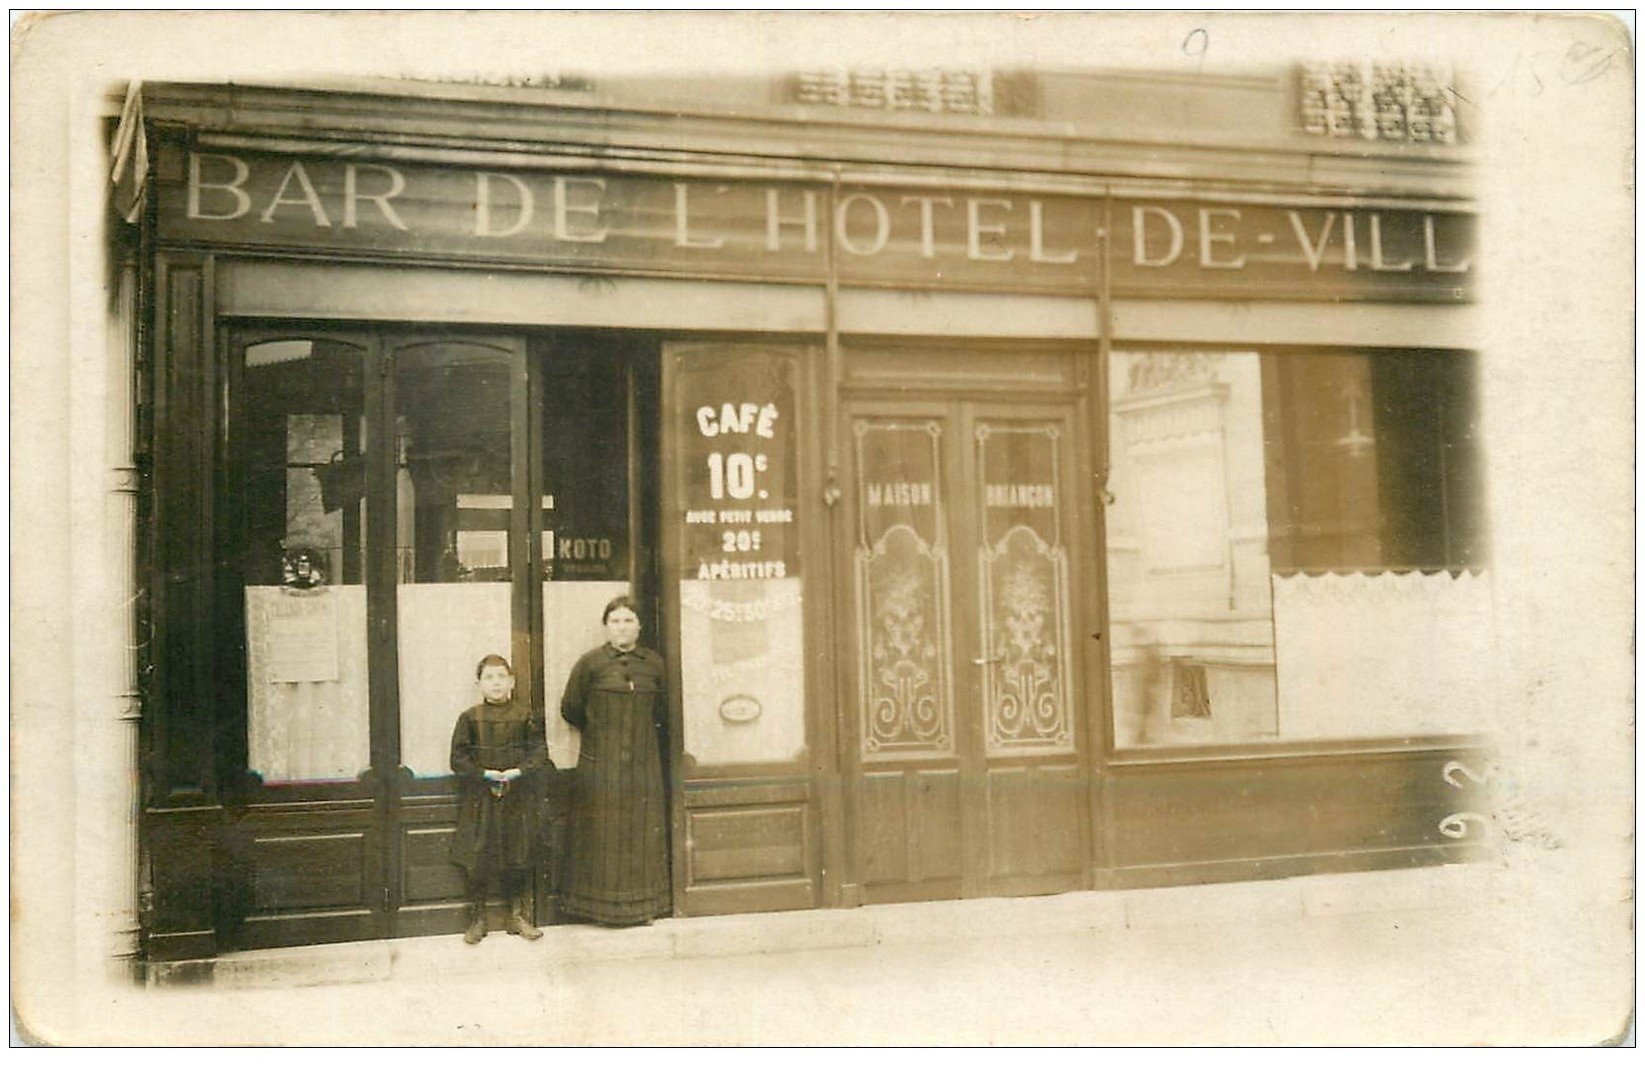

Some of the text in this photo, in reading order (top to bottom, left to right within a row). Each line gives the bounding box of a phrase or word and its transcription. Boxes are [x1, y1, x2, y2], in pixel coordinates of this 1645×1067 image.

[186, 151, 409, 232] BAR
[475, 172, 609, 244] DE
[697, 402, 779, 440] CAFÉ
[867, 481, 931, 506] MAISON
[559, 538, 612, 560] KOTO
[698, 559, 787, 580] APÉRITIFS
